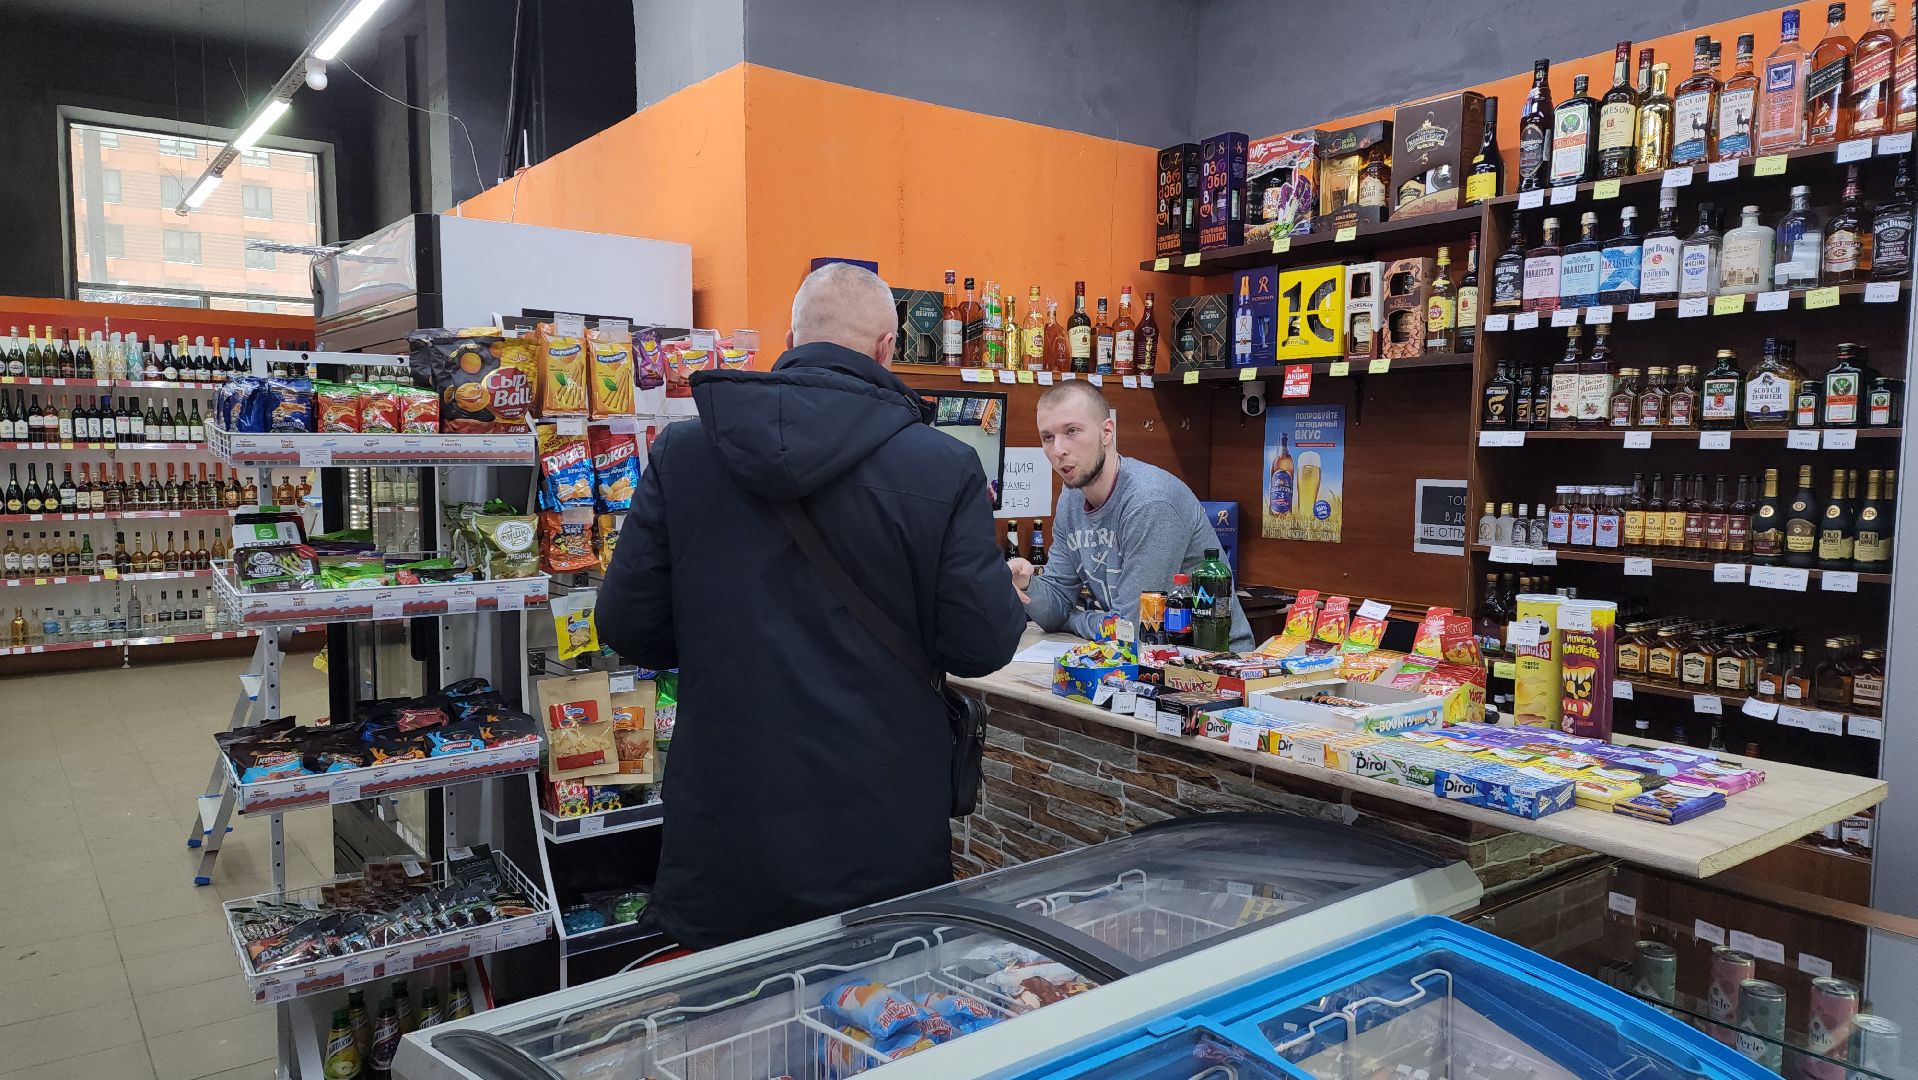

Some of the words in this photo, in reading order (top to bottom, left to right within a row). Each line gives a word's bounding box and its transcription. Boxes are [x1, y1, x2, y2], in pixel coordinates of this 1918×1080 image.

[1874, 222, 1889, 234] JACK
[487, 373, 527, 391] Сыр
[1753, 386, 1781, 394] SCOTCH
[493, 387, 532, 407] Ball
[1295, 410, 1339, 419] ПОПРОБУЙТЕ
[1294, 429, 1321, 440] ВКУС
[1445, 511, 1451, 522] В
[1423, 526, 1435, 537] НЕ
[1566, 635, 1598, 647] HUNGRY
[1562, 643, 1600, 661] MONSTERS
[1206, 721, 1228, 733] Dirol
[1379, 715, 1413, 732] BOUNTY
[1278, 739, 1293, 750] Dir
[1356, 756, 1387, 772] Dirol
[1445, 779, 1476, 795] Dirol
[1736, 1032, 1764, 1054] Perle
